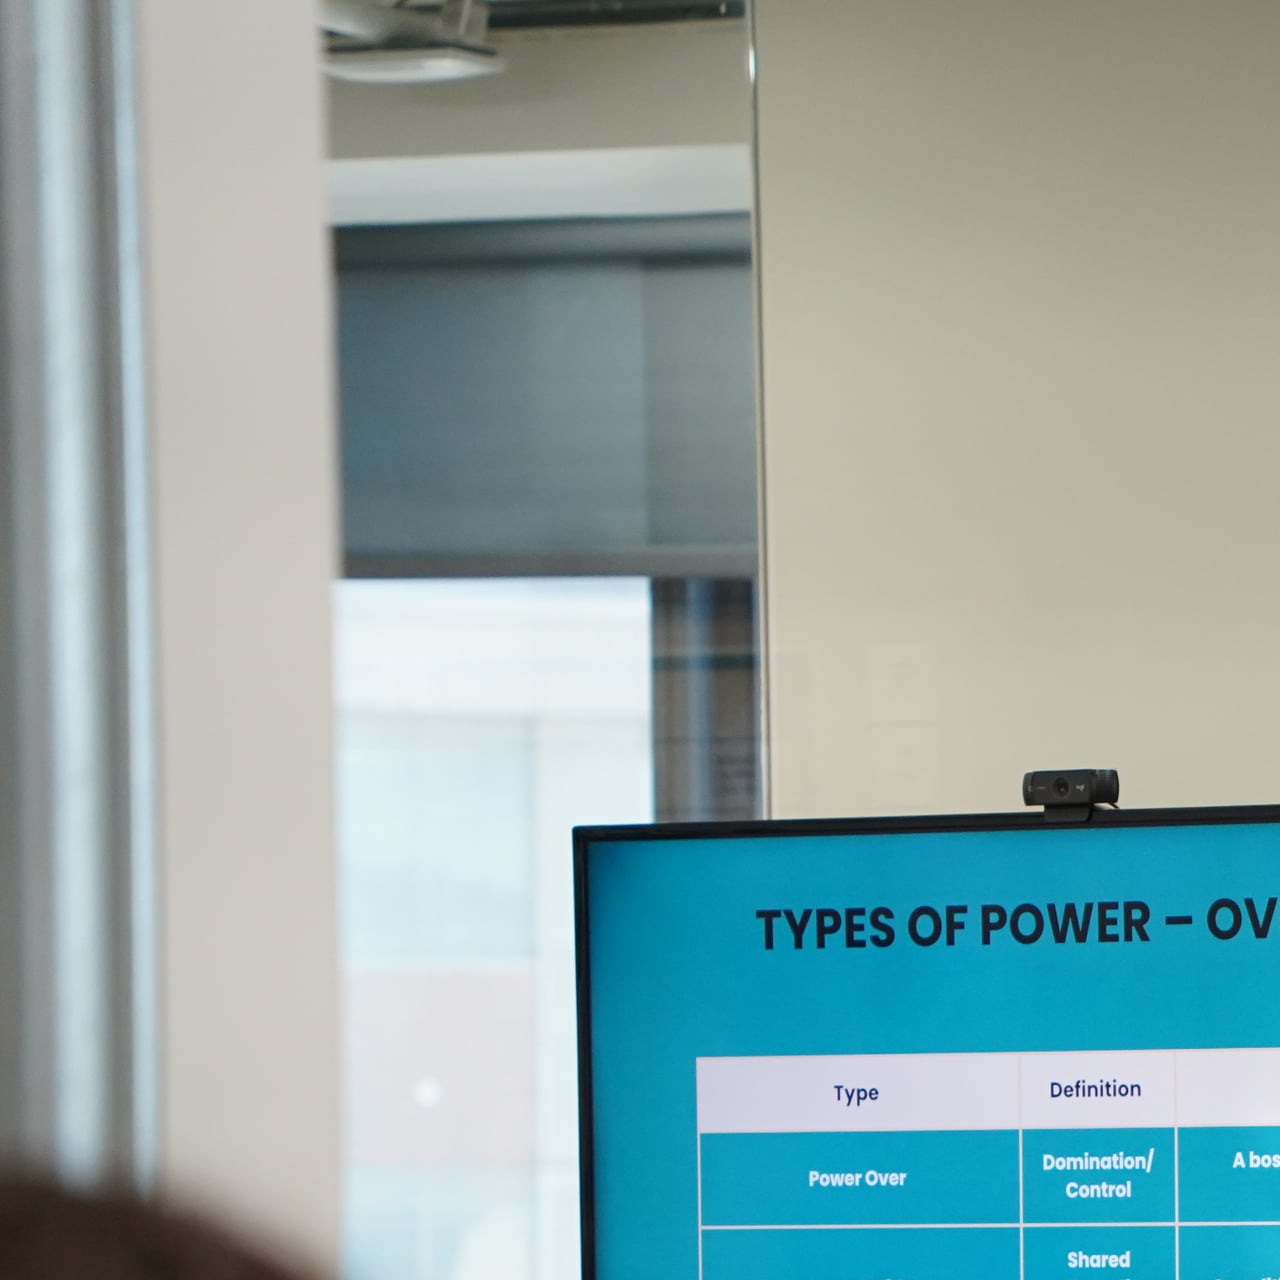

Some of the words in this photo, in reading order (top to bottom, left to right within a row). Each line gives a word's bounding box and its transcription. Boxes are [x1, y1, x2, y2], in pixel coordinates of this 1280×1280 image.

[756, 907, 895, 950] TYPES
[908, 905, 968, 946] OF
[981, 900, 1150, 945] POWER
[834, 1085, 879, 1107] Type
[1050, 1079, 1142, 1098] Definition
[1043, 1148, 1155, 1174] Domination/
[1232, 1151, 1246, 1168] A
[809, 1170, 862, 1187] Power
[865, 1170, 907, 1187] Over
[1065, 1180, 1131, 1199] Control
[1067, 1251, 1131, 1269] Shared
